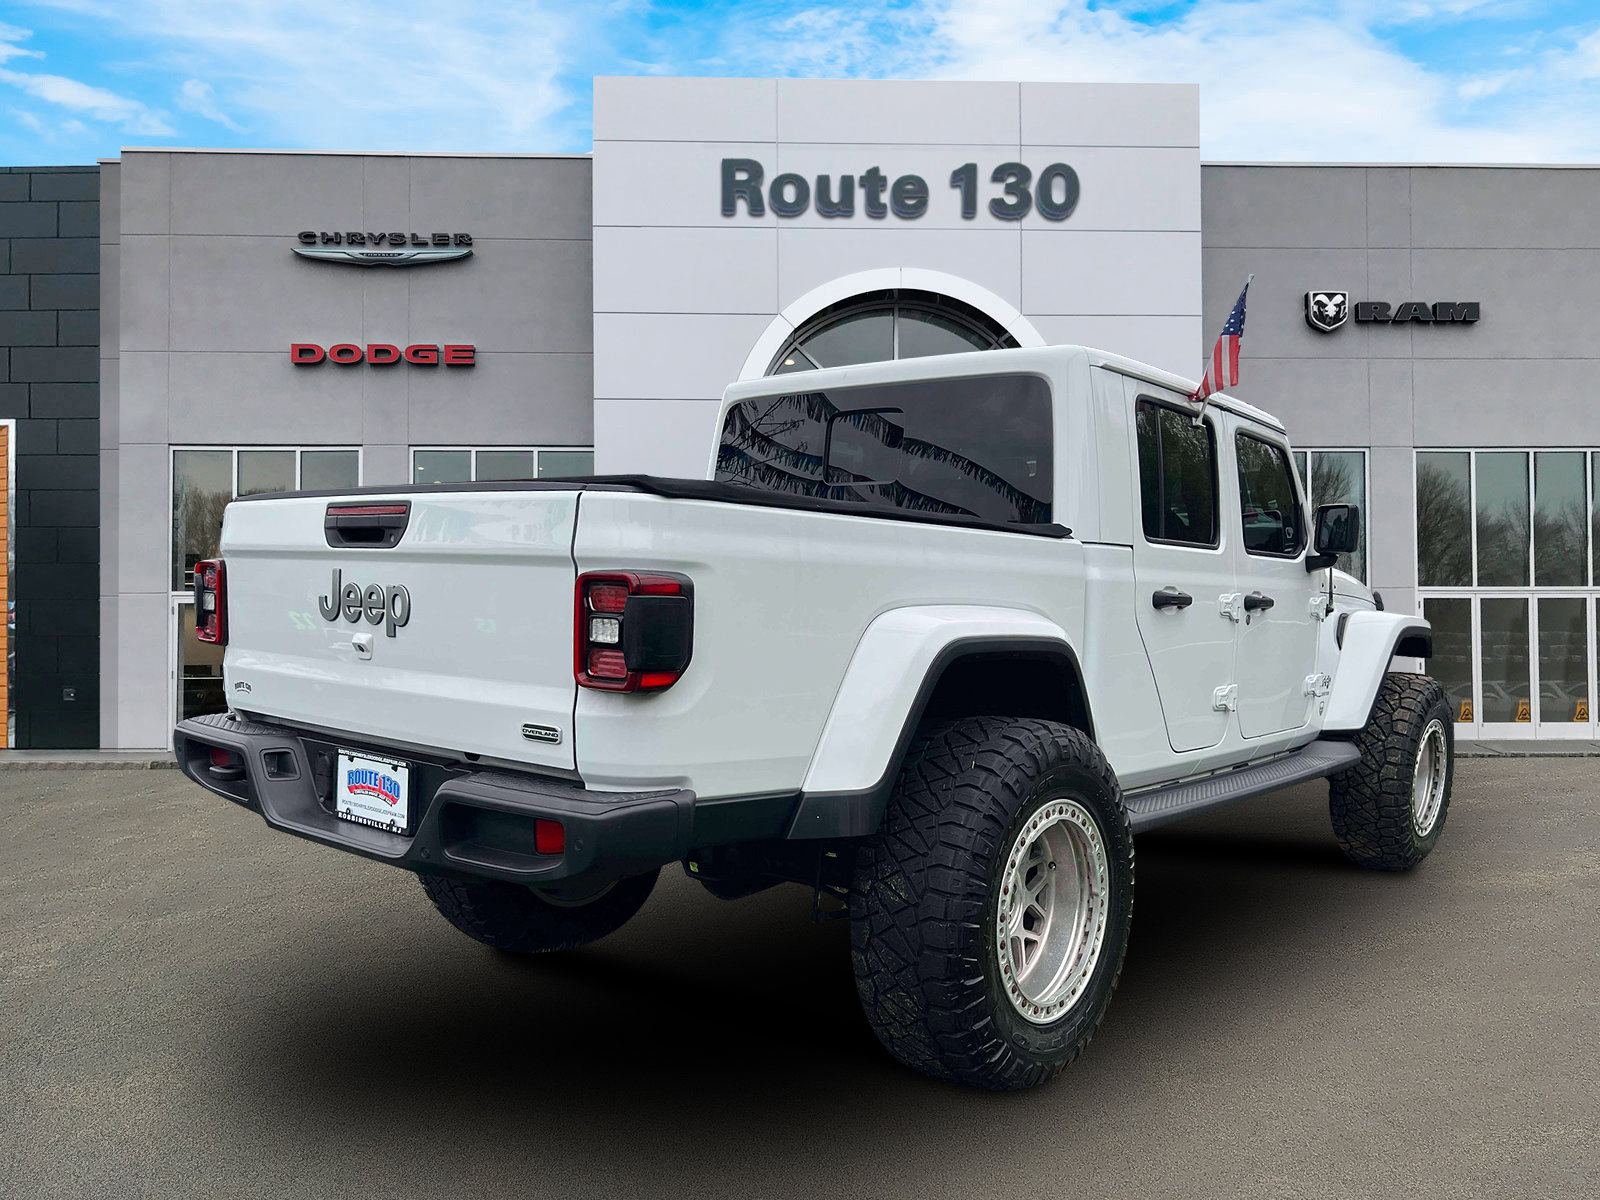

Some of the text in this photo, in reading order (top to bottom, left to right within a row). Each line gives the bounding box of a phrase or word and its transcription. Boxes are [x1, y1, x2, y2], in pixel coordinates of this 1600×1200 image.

[720, 157, 1081, 220] Route 130
[298, 231, 473, 245] CHRYSLER
[1355, 302, 1480, 323] RAM
[291, 343, 476, 366] DODGE
[318, 568, 411, 638] Jeep
[522, 728, 559, 738] OVERLAND
[347, 768, 379, 787] ROUTE
[381, 774, 401, 799] 130
